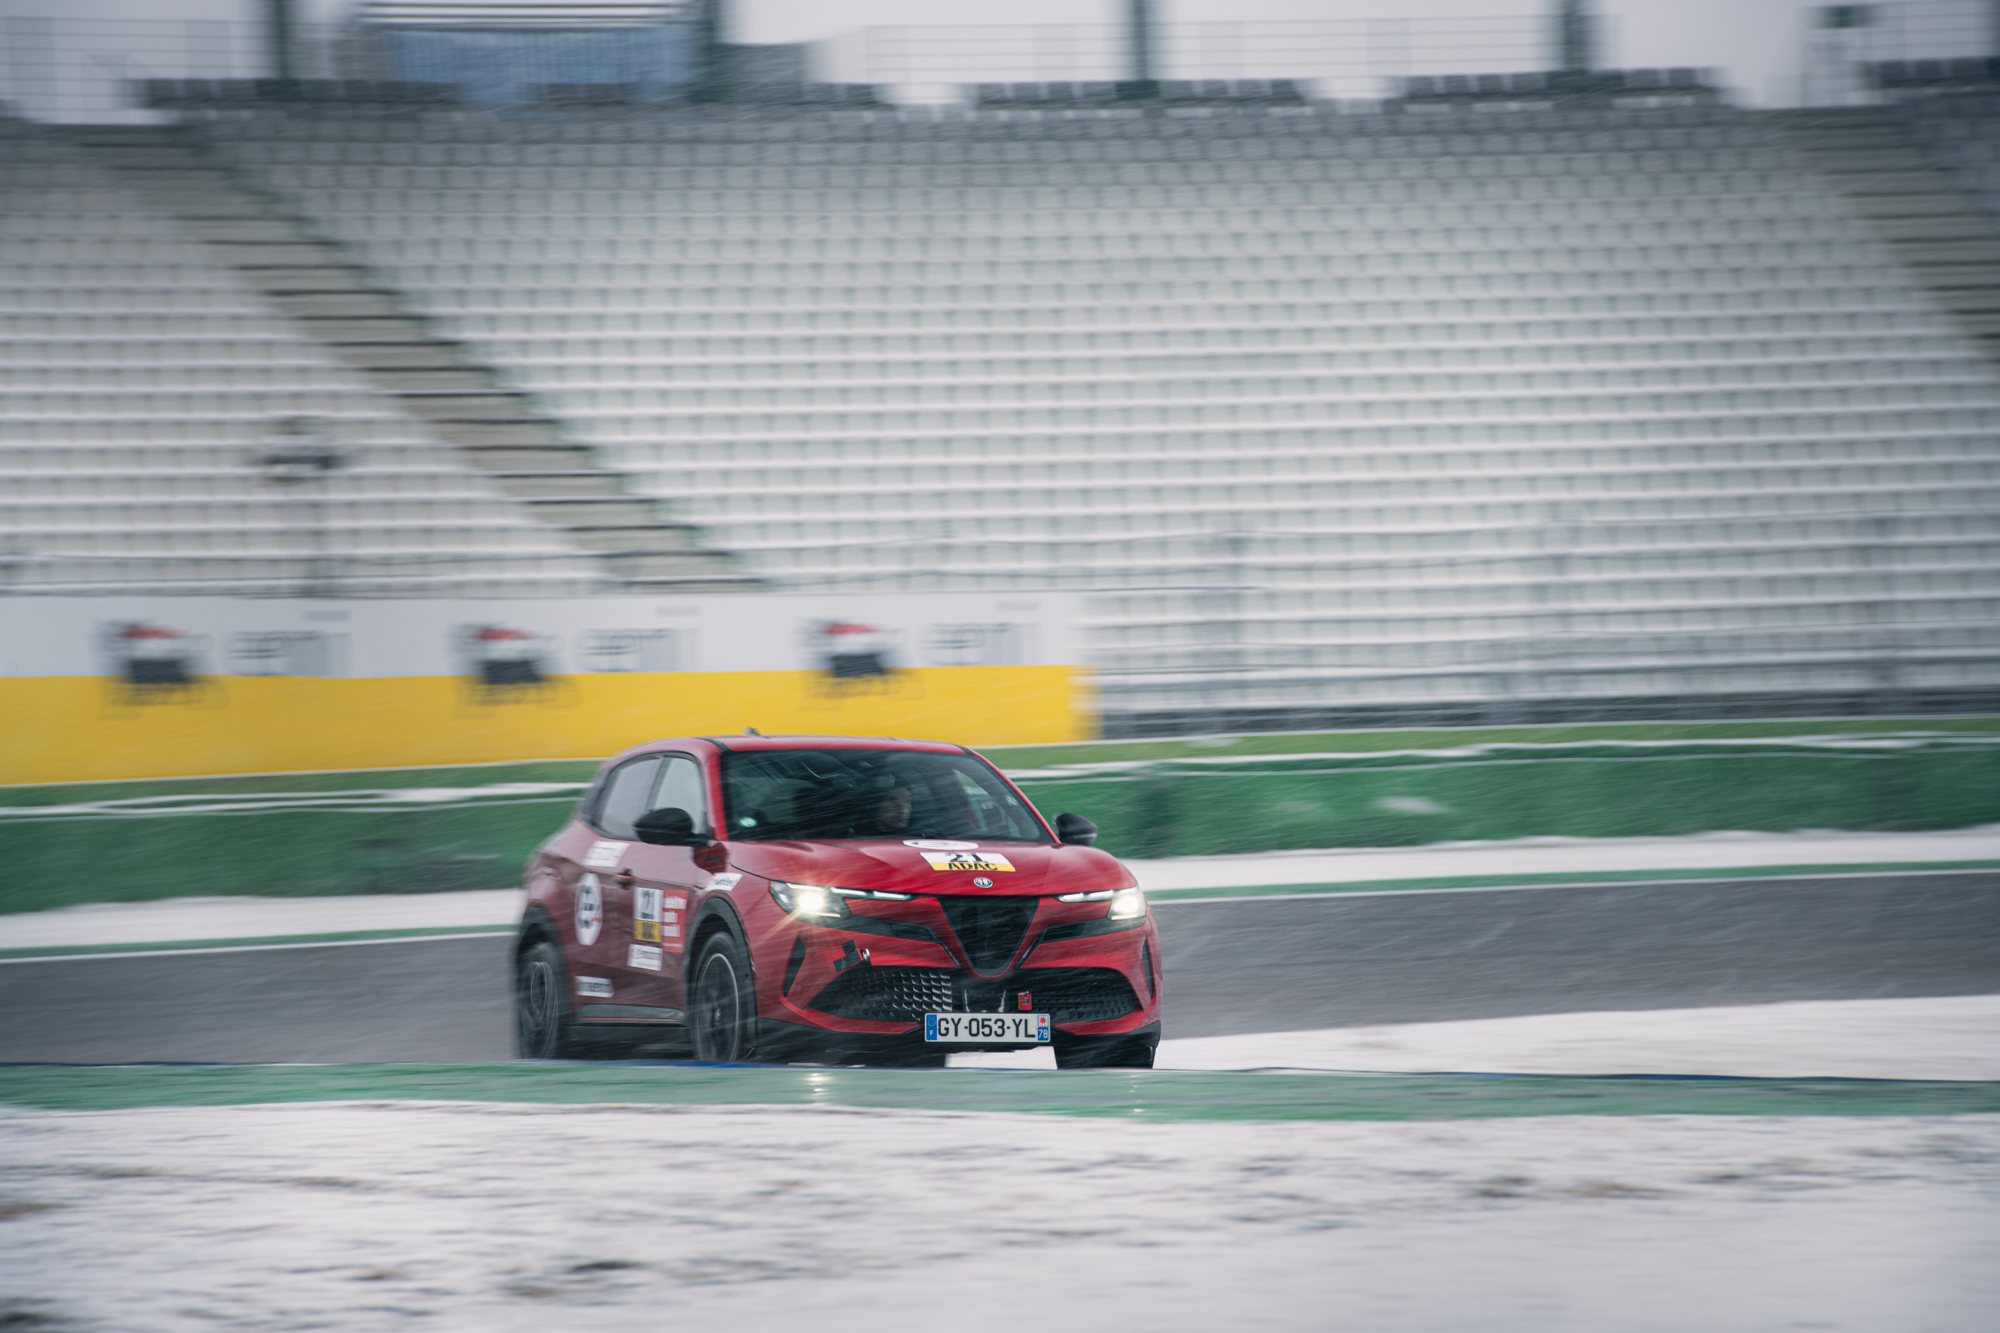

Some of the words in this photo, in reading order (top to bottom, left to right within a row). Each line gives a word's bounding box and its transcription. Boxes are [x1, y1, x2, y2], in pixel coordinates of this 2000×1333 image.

[945, 853, 985, 863] 21
[948, 862, 998, 871] ADAC
[937, 1017, 1036, 1038] GY-053-YL
[1038, 1029, 1049, 1039] 78
